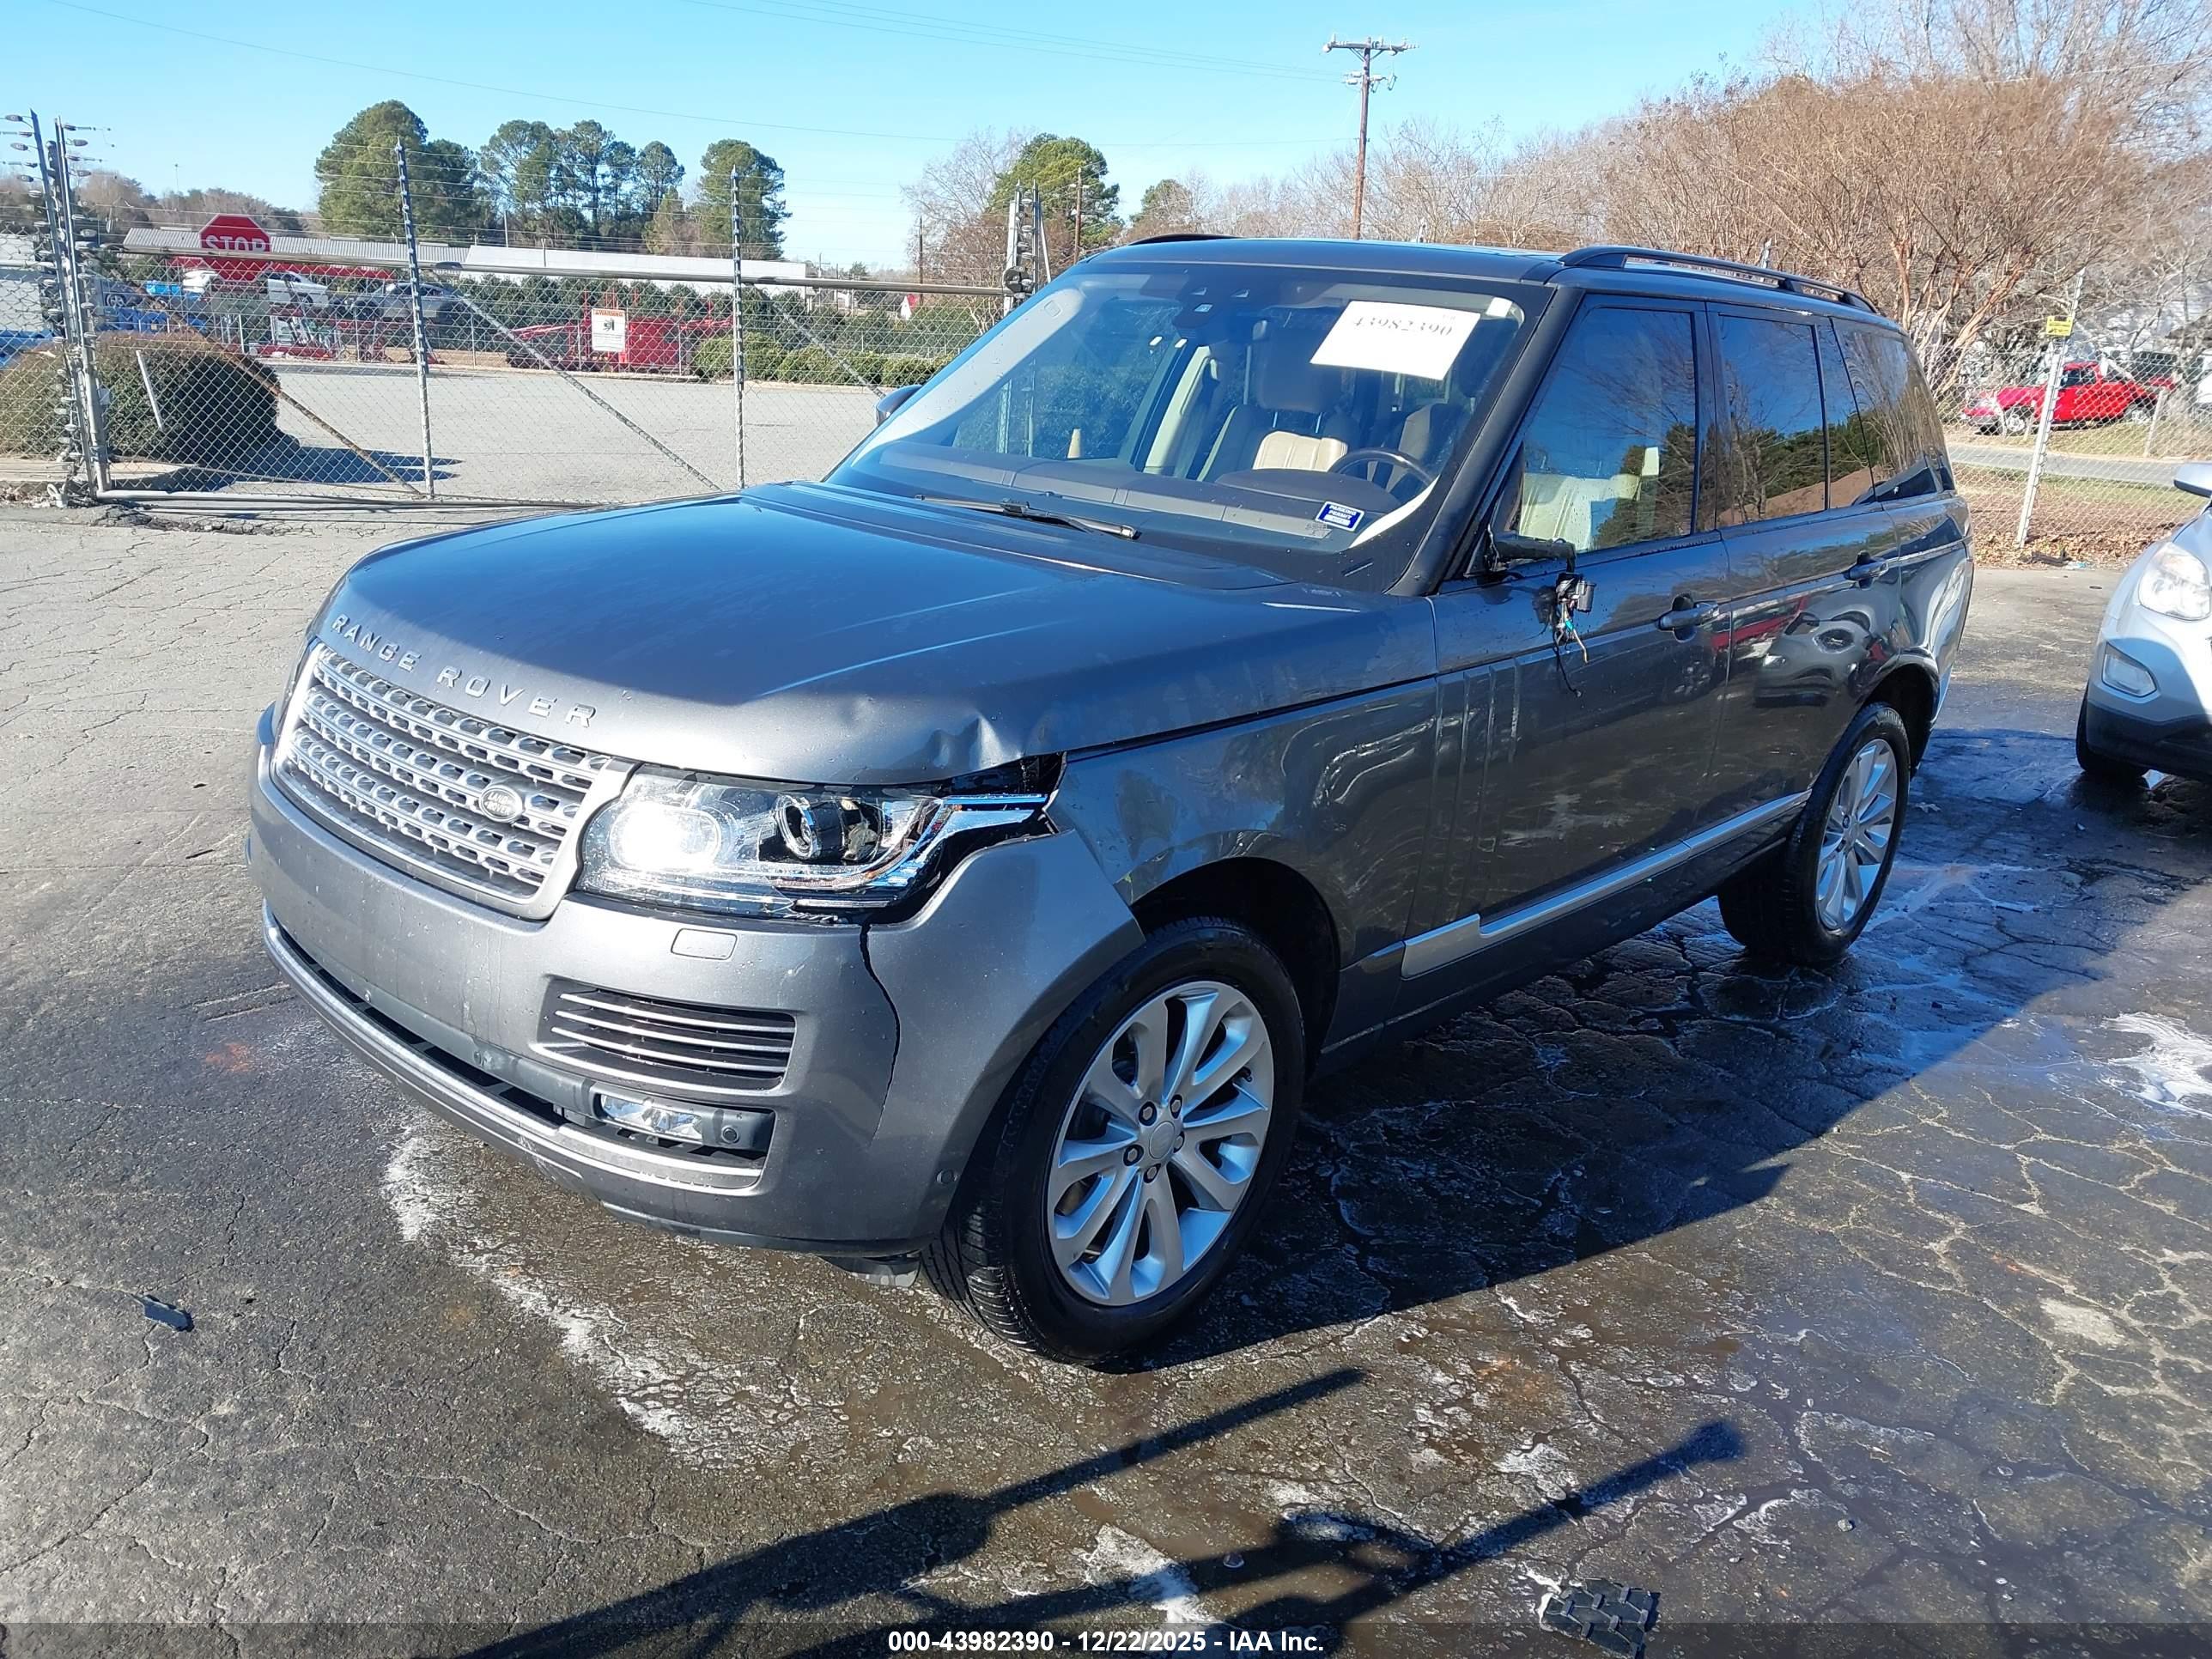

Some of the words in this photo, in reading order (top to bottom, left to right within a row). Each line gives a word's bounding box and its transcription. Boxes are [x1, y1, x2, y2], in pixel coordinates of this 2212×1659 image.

[206, 234, 266, 252] STOP
[1353, 316, 1453, 336] 43982390
[1328, 510, 1352, 520] PERMIT
[1329, 505, 1357, 516] PARKING
[330, 614, 422, 672] RANGE
[436, 665, 597, 728] ROVER
[488, 792, 509, 805] LAND
